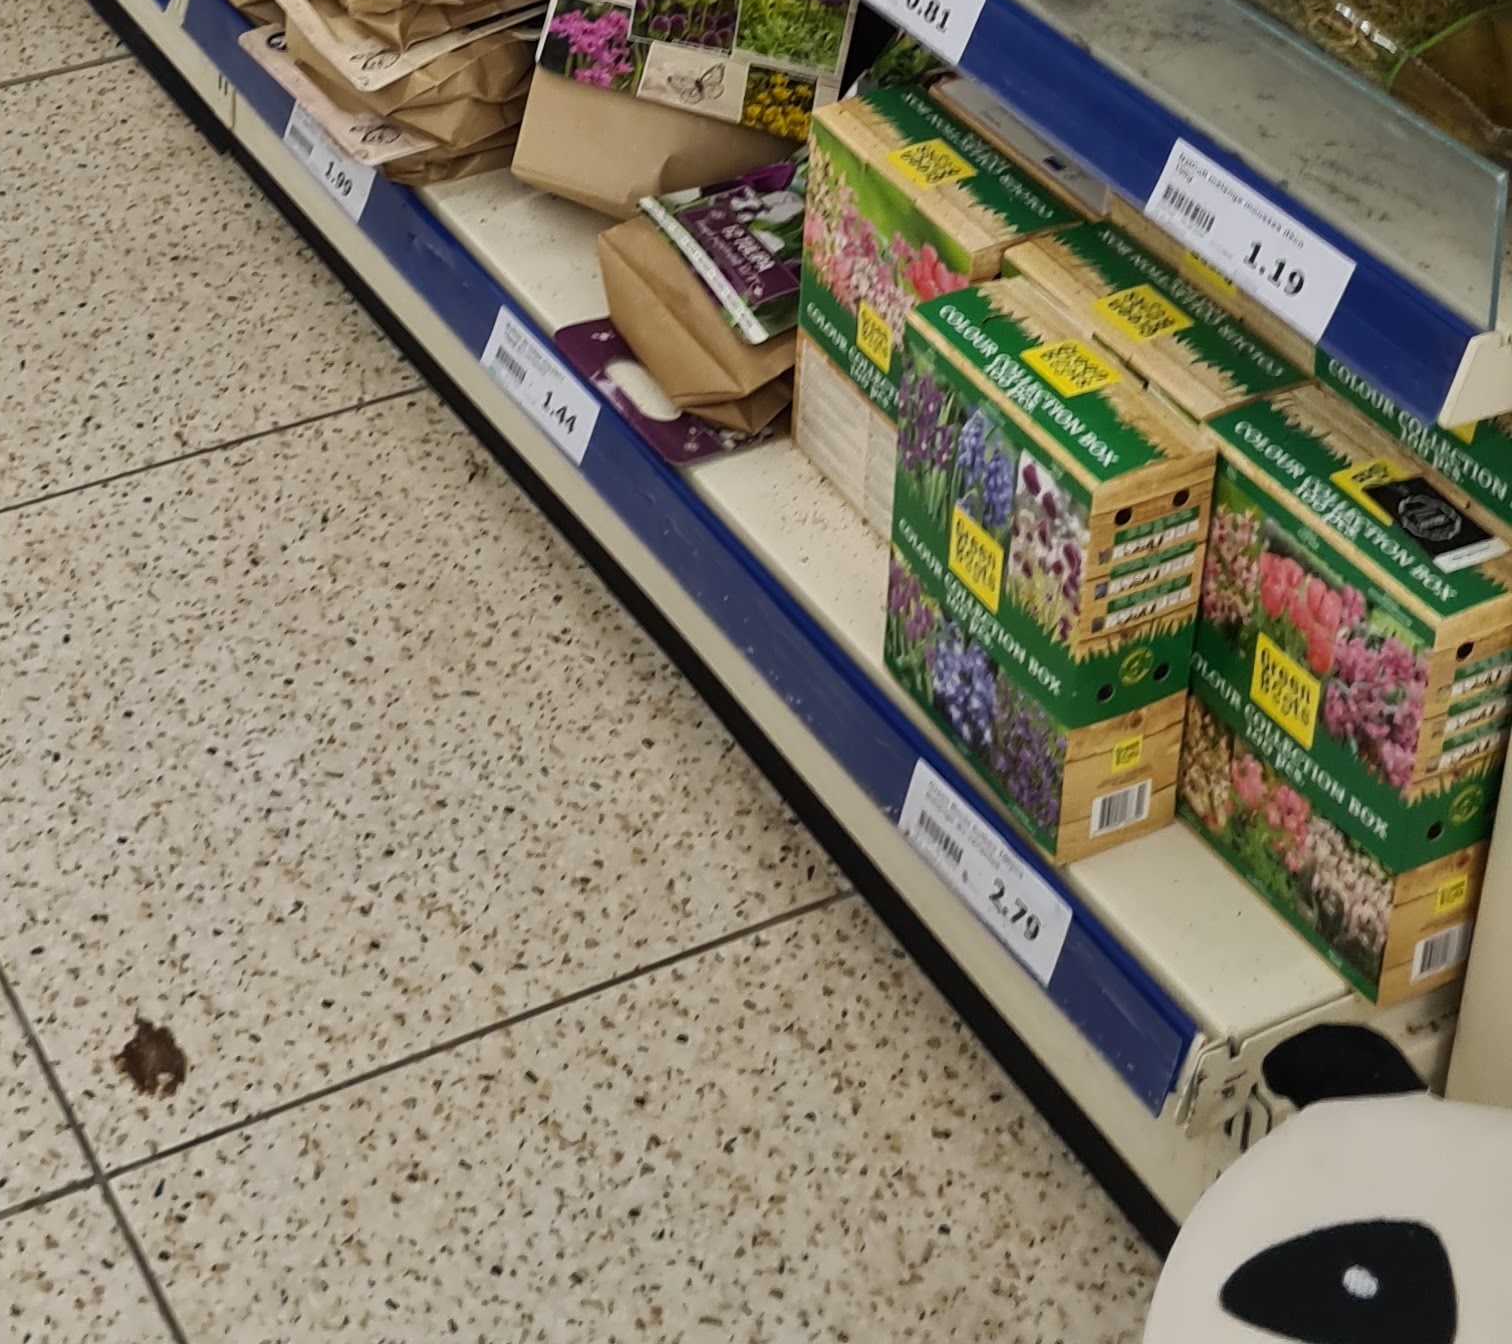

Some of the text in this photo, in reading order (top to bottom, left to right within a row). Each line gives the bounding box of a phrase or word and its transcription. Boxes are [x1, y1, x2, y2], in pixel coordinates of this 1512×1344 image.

[325, 161, 353, 198] 1.99
[1243, 240, 1305, 297] 1.19
[542, 391, 578, 434] 1.44
[939, 305, 998, 358] COLOUR
[995, 353, 1086, 436] COLLECTION
[1078, 431, 1119, 468] BOX
[1329, 359, 1508, 501] COLOUR COLLECTION
[1234, 420, 1458, 602] COLOUR COLLECTION BOX
[1028, 656, 1061, 697] BOX
[1192, 651, 1388, 840] OLOUR COLLECTION BOX
[988, 877, 1041, 942] 2.79
